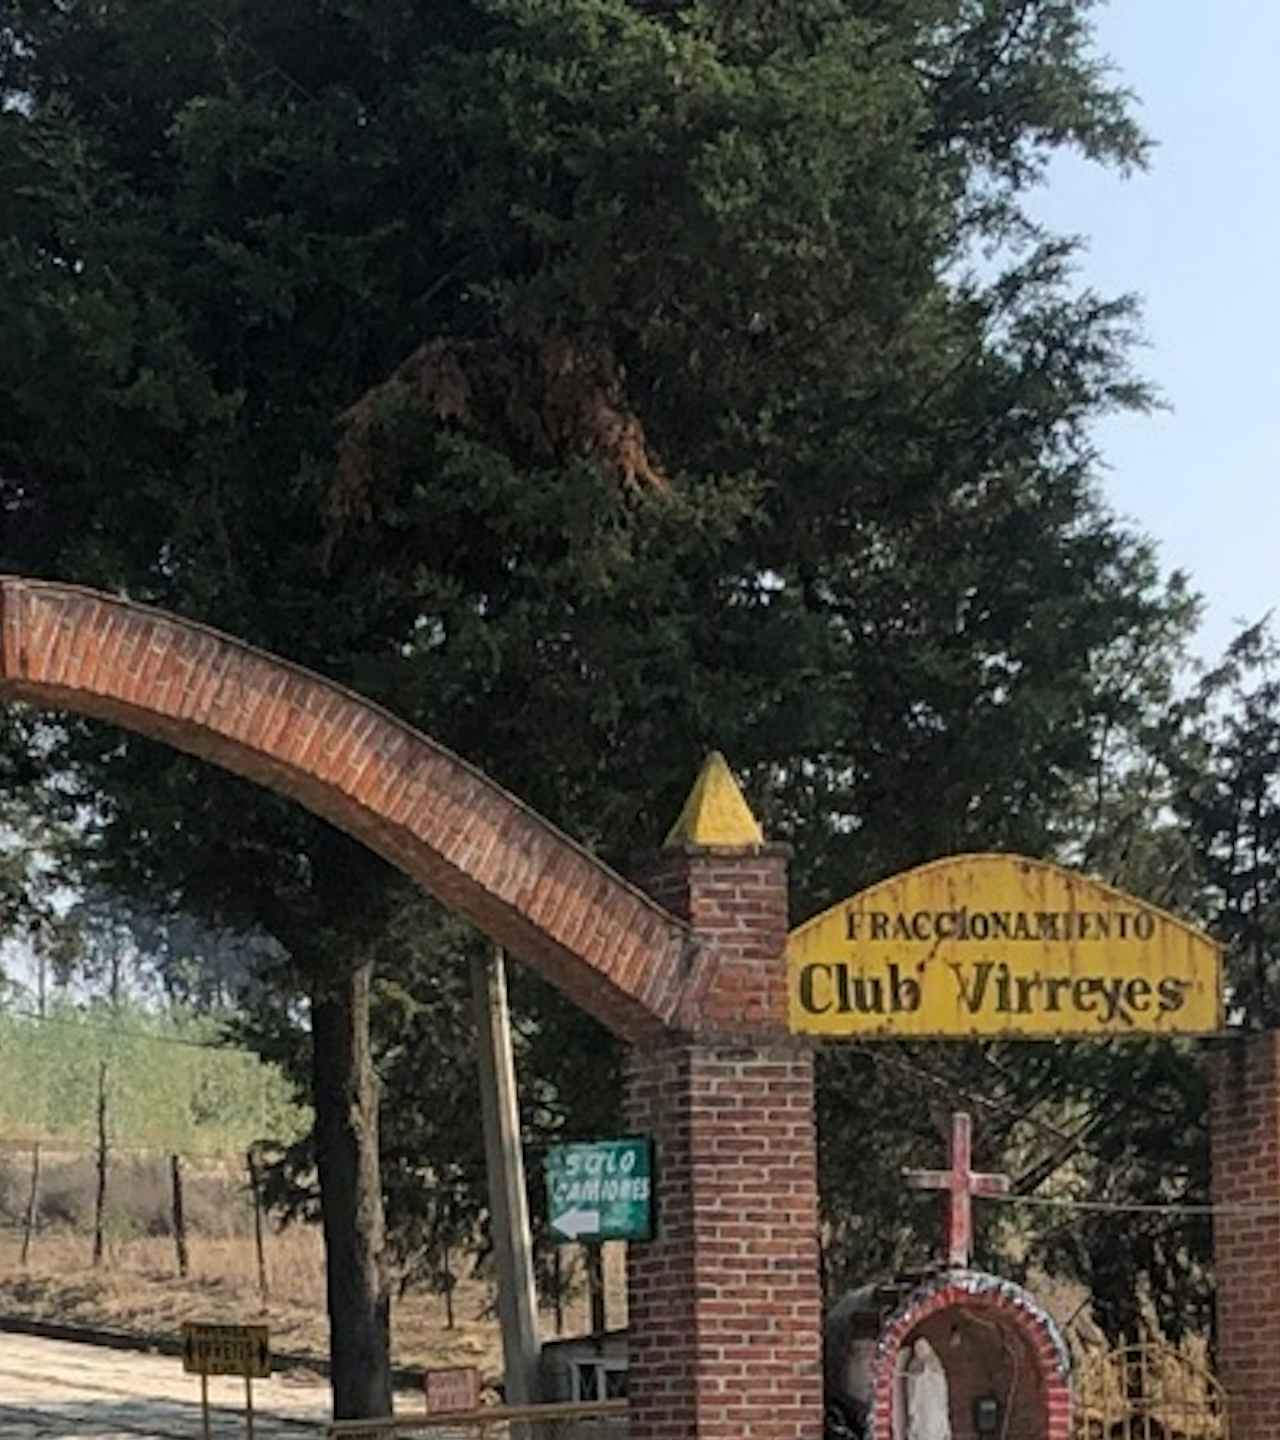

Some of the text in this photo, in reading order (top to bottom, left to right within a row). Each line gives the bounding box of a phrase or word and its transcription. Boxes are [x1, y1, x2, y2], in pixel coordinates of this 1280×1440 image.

[845, 907, 1156, 941] FRACCIONAMIENTO
[798, 961, 1194, 1024] Club Virreyes
[564, 1150, 637, 1176] SOLO
